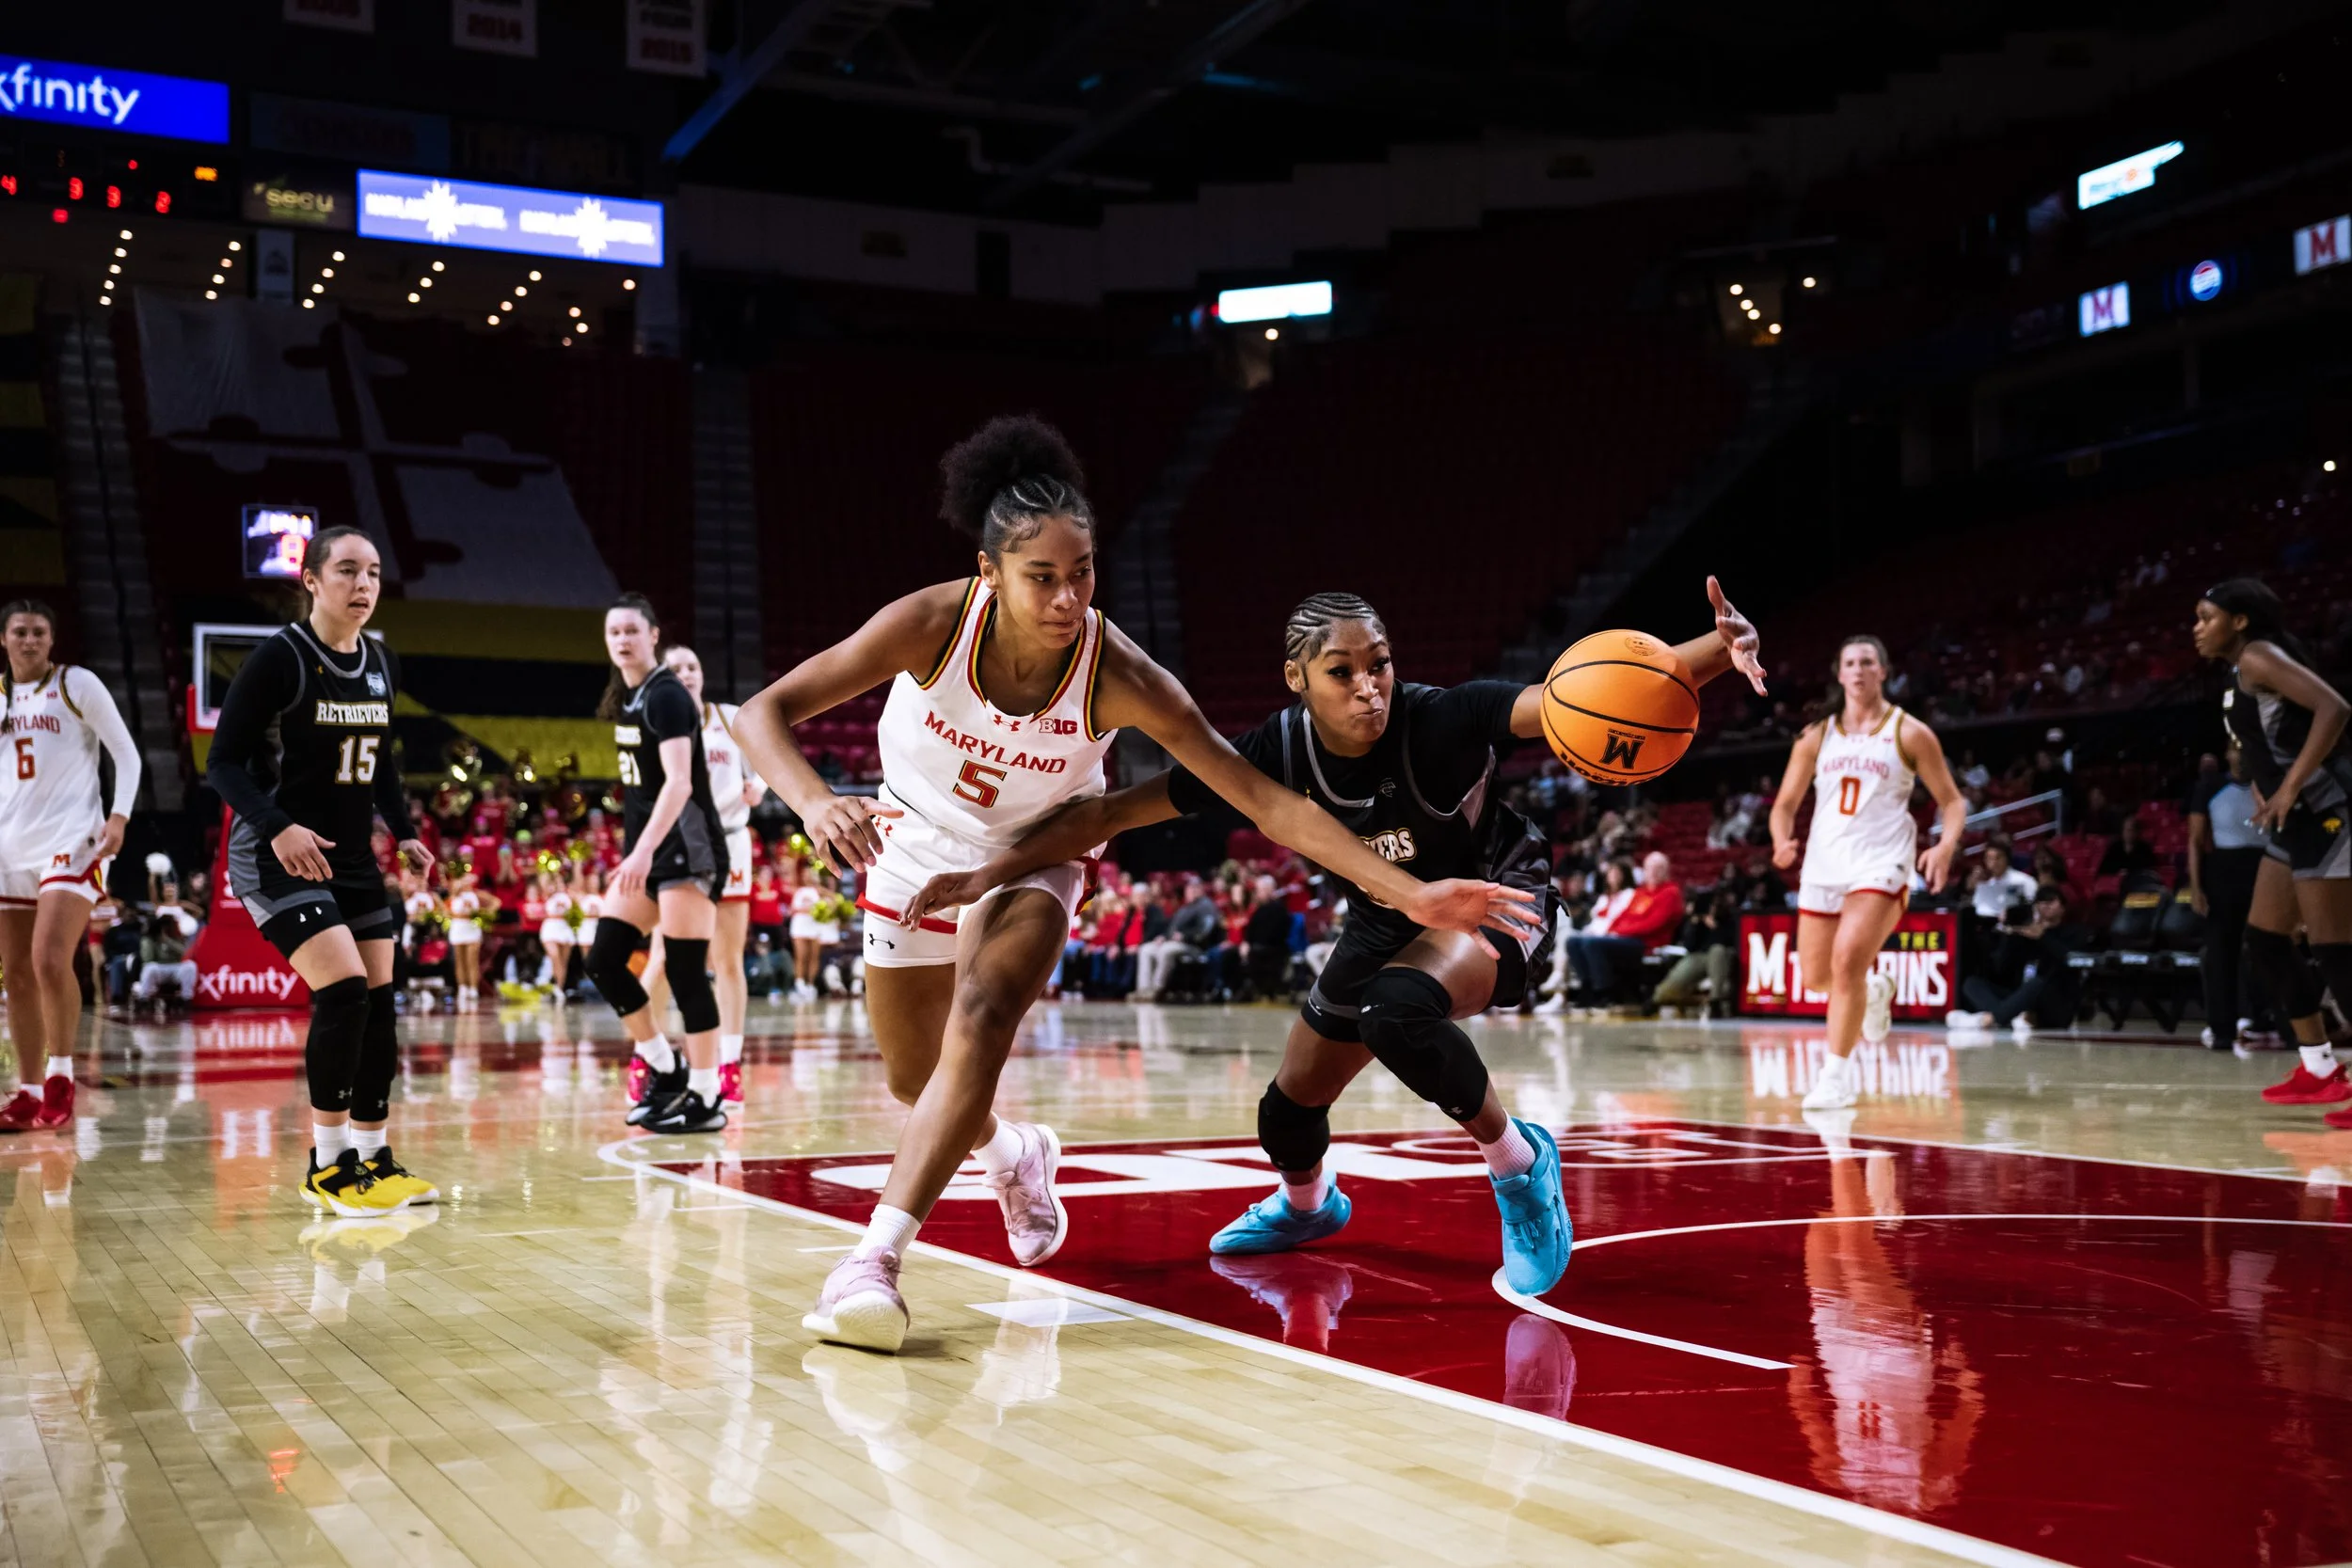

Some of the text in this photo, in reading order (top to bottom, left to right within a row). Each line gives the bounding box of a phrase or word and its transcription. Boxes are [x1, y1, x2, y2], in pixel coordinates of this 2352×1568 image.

[2310, 220, 2338, 265] M
[2091, 289, 2115, 331] M
[314, 699, 389, 727] RETRIEVERS
[15, 736, 36, 781] 6
[335, 735, 381, 784] 15
[923, 710, 1067, 774] MARYLAND
[617, 751, 643, 786] 21
[952, 759, 1009, 809] 5
[1822, 753, 1891, 780] MARYLAND
[1839, 776, 1862, 816] 0
[52, 853, 71, 868] M
[1899, 931, 1940, 950] THE
[199, 964, 298, 1001] xfinity
[1746, 932, 1788, 995] M
[1788, 950, 1949, 1006] TPINS
